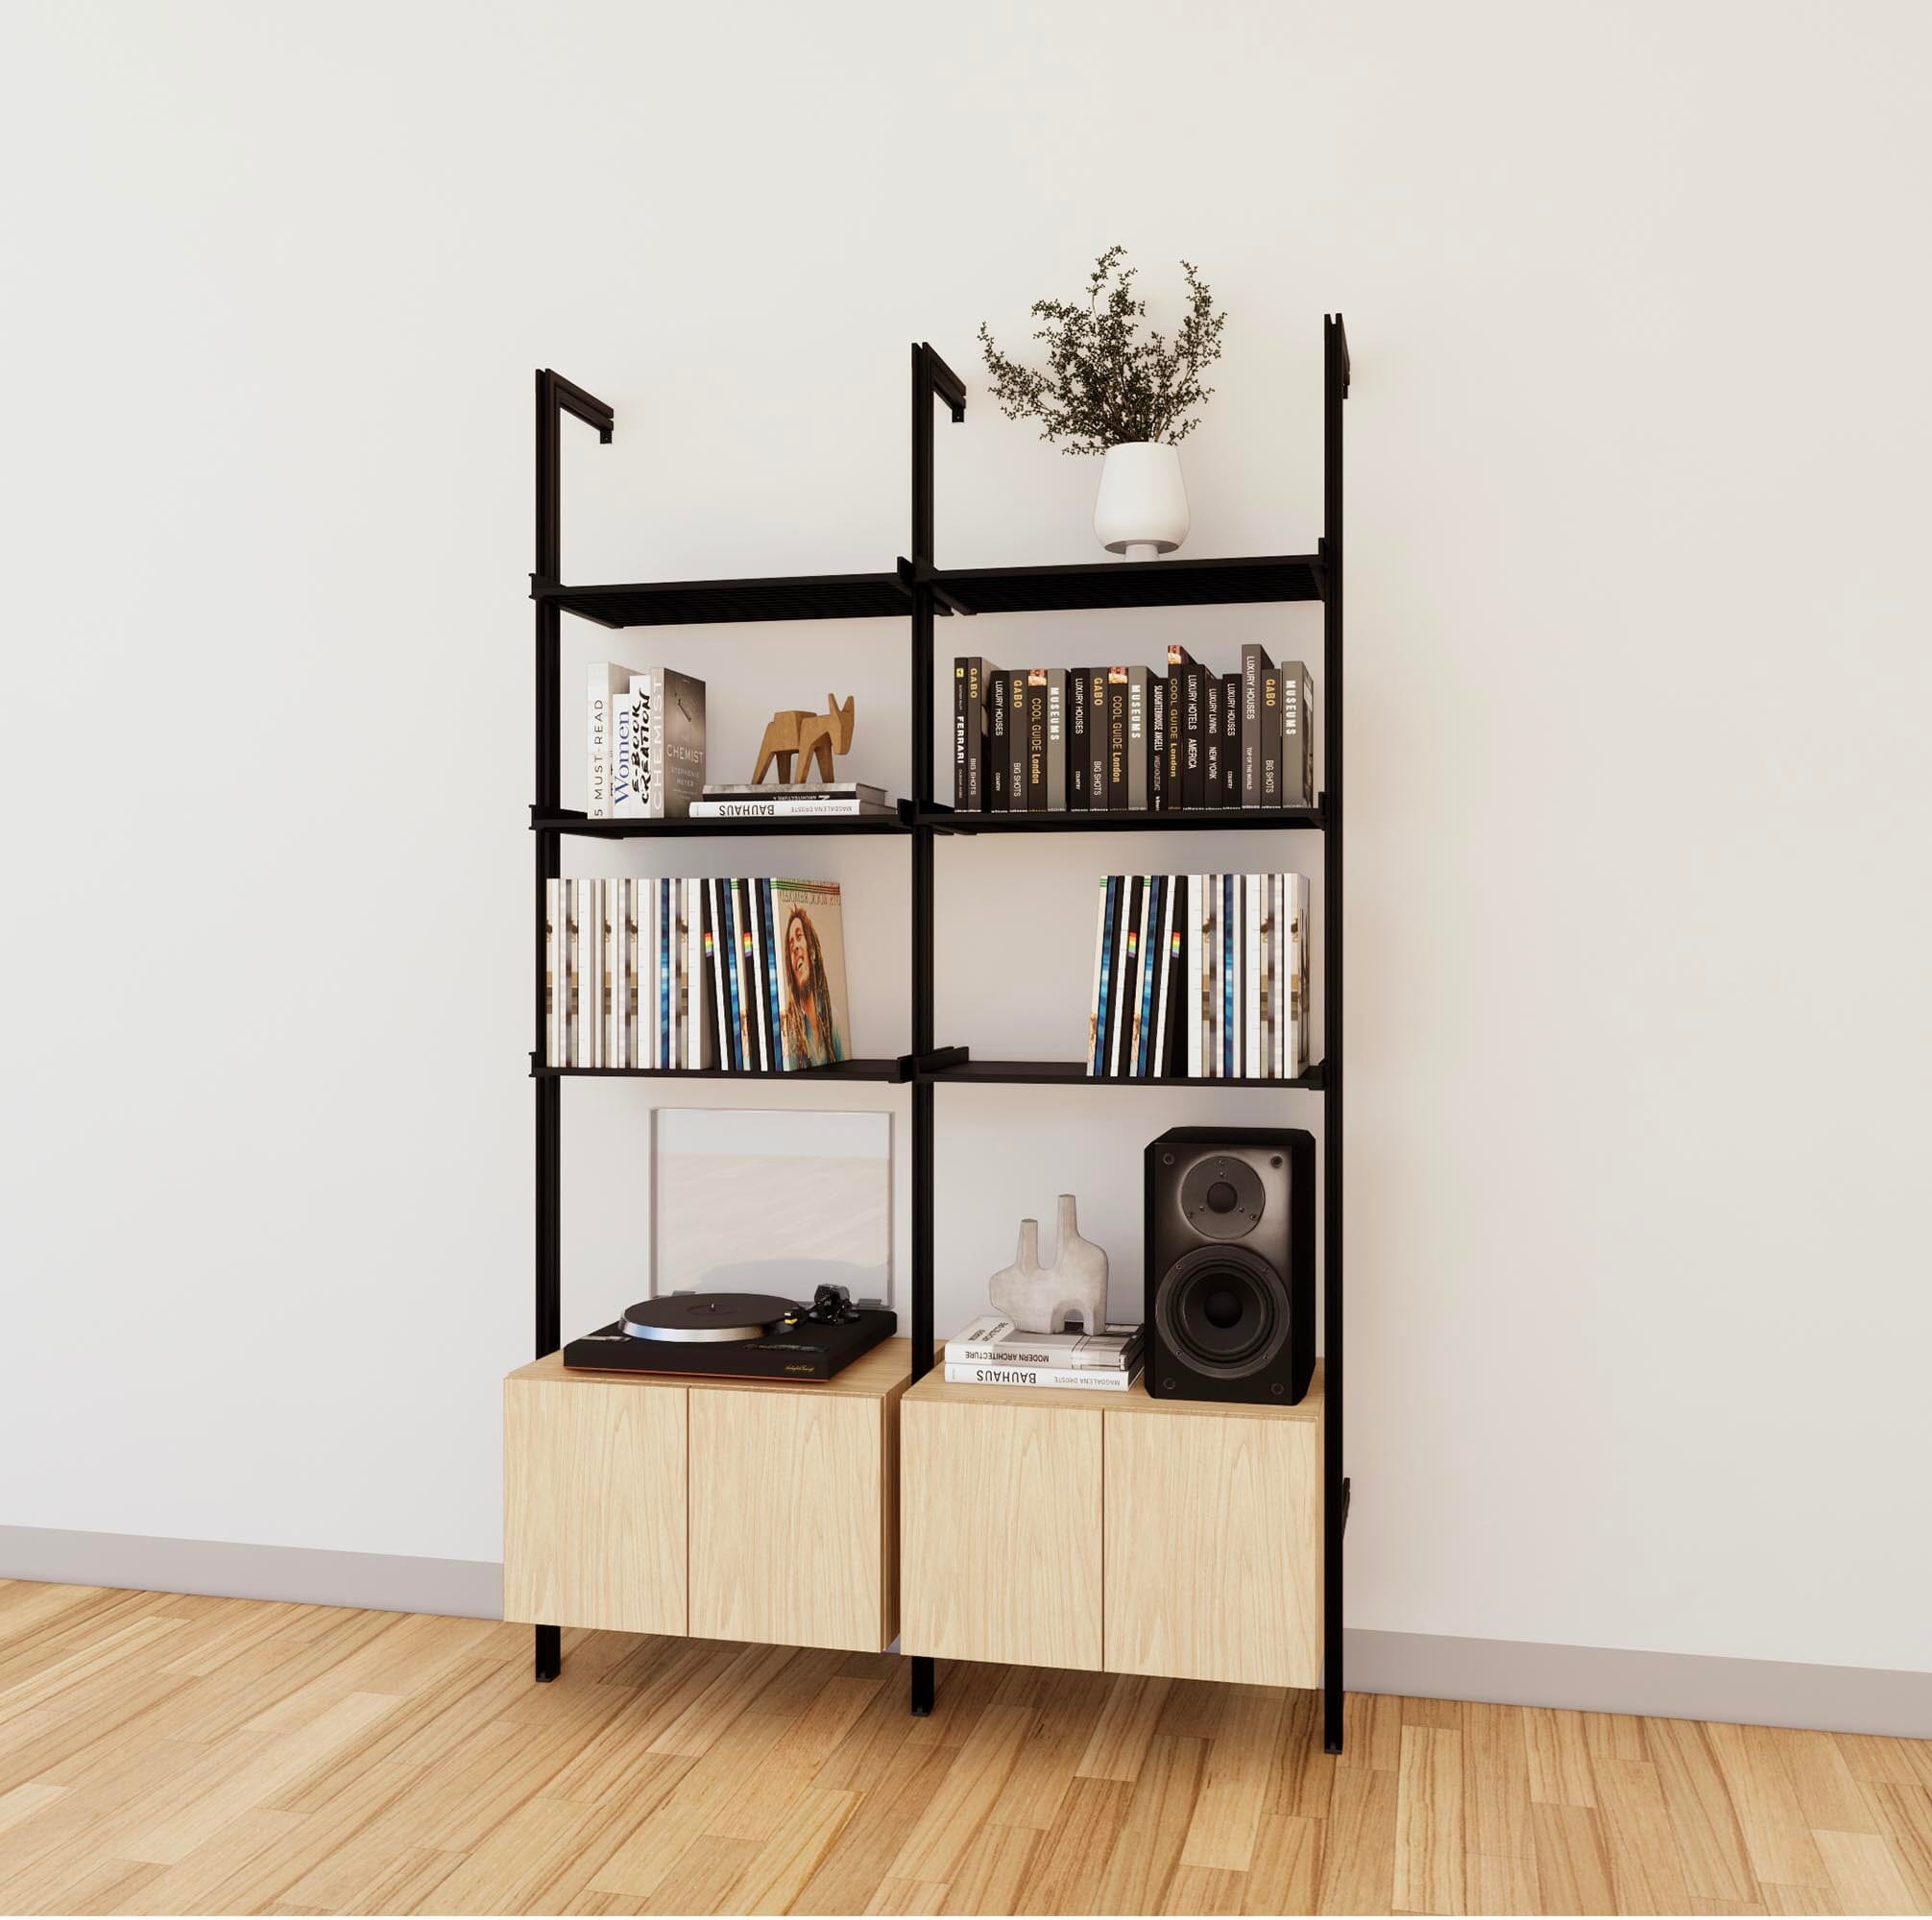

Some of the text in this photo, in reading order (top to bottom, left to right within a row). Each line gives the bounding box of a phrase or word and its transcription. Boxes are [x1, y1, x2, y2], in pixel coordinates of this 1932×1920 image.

[1014, 680, 1022, 708] GABO
[1051, 687, 1060, 741] MUSEUMS
[1094, 677, 1103, 706] GABO
[1131, 684, 1141, 739] MUSEUMS
[1227, 683, 1235, 736] LUXURY HOUSES
[1266, 678, 1275, 707] GABO
[1285, 680, 1296, 735] MUSEUMS
[631, 700, 641, 792] E-BOOK
[639, 687, 651, 804] CREATION
[654, 680, 662, 810] CHEMIST
[1032, 697, 1041, 784] COOL GUIDE London
[1112, 695, 1122, 782] COOL GUIDE London
[1154, 732, 1162, 751] ANGELS
[1170, 678, 1178, 778] COOL GUIDE London
[1188, 674, 1197, 769] LUXURY HOTELS AMERICA
[594, 699, 604, 800] MUST-READ
[615, 710, 629, 804] Women
[666, 744, 704, 764] CHEMIST
[1266, 759, 1274, 793] BIG SHOTS
[719, 804, 775, 816] BAUHAUS
[965, 1350, 1050, 1363] MODERN ARCHITECTURE
[976, 1369, 1037, 1384] BAUHAUS
[1079, 1377, 1121, 1386] MAGDALENA
